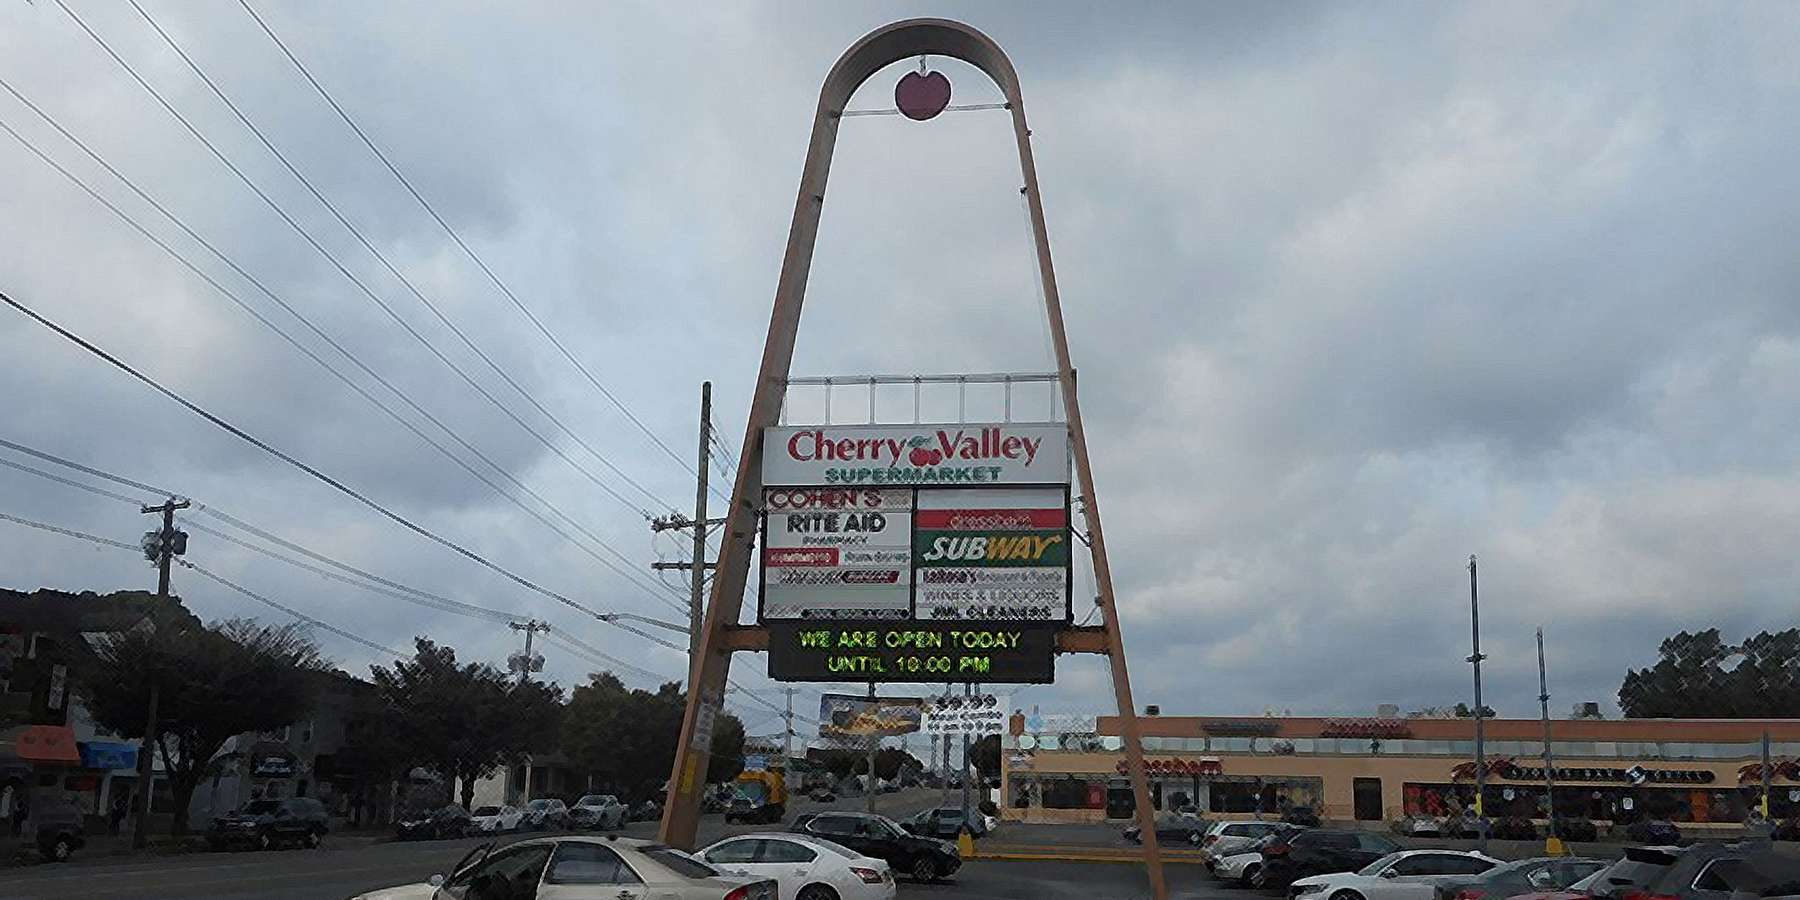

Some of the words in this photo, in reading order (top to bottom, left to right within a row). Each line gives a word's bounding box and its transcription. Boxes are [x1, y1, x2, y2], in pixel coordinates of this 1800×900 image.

[787, 430, 907, 468] Cherry
[937, 427, 1042, 468] Valley
[824, 466, 1003, 484] SUPERMARKET
[786, 512, 840, 533] RITE
[843, 511, 887, 533] AID
[923, 534, 1063, 563] SUBWAY
[799, 631, 831, 648] WE
[838, 631, 878, 648] ARE
[885, 631, 942, 648] OPEN
[951, 631, 1022, 648] TODAY
[827, 656, 888, 673] UNTIL
[896, 656, 951, 673] 10:00
[959, 656, 992, 673] PM
